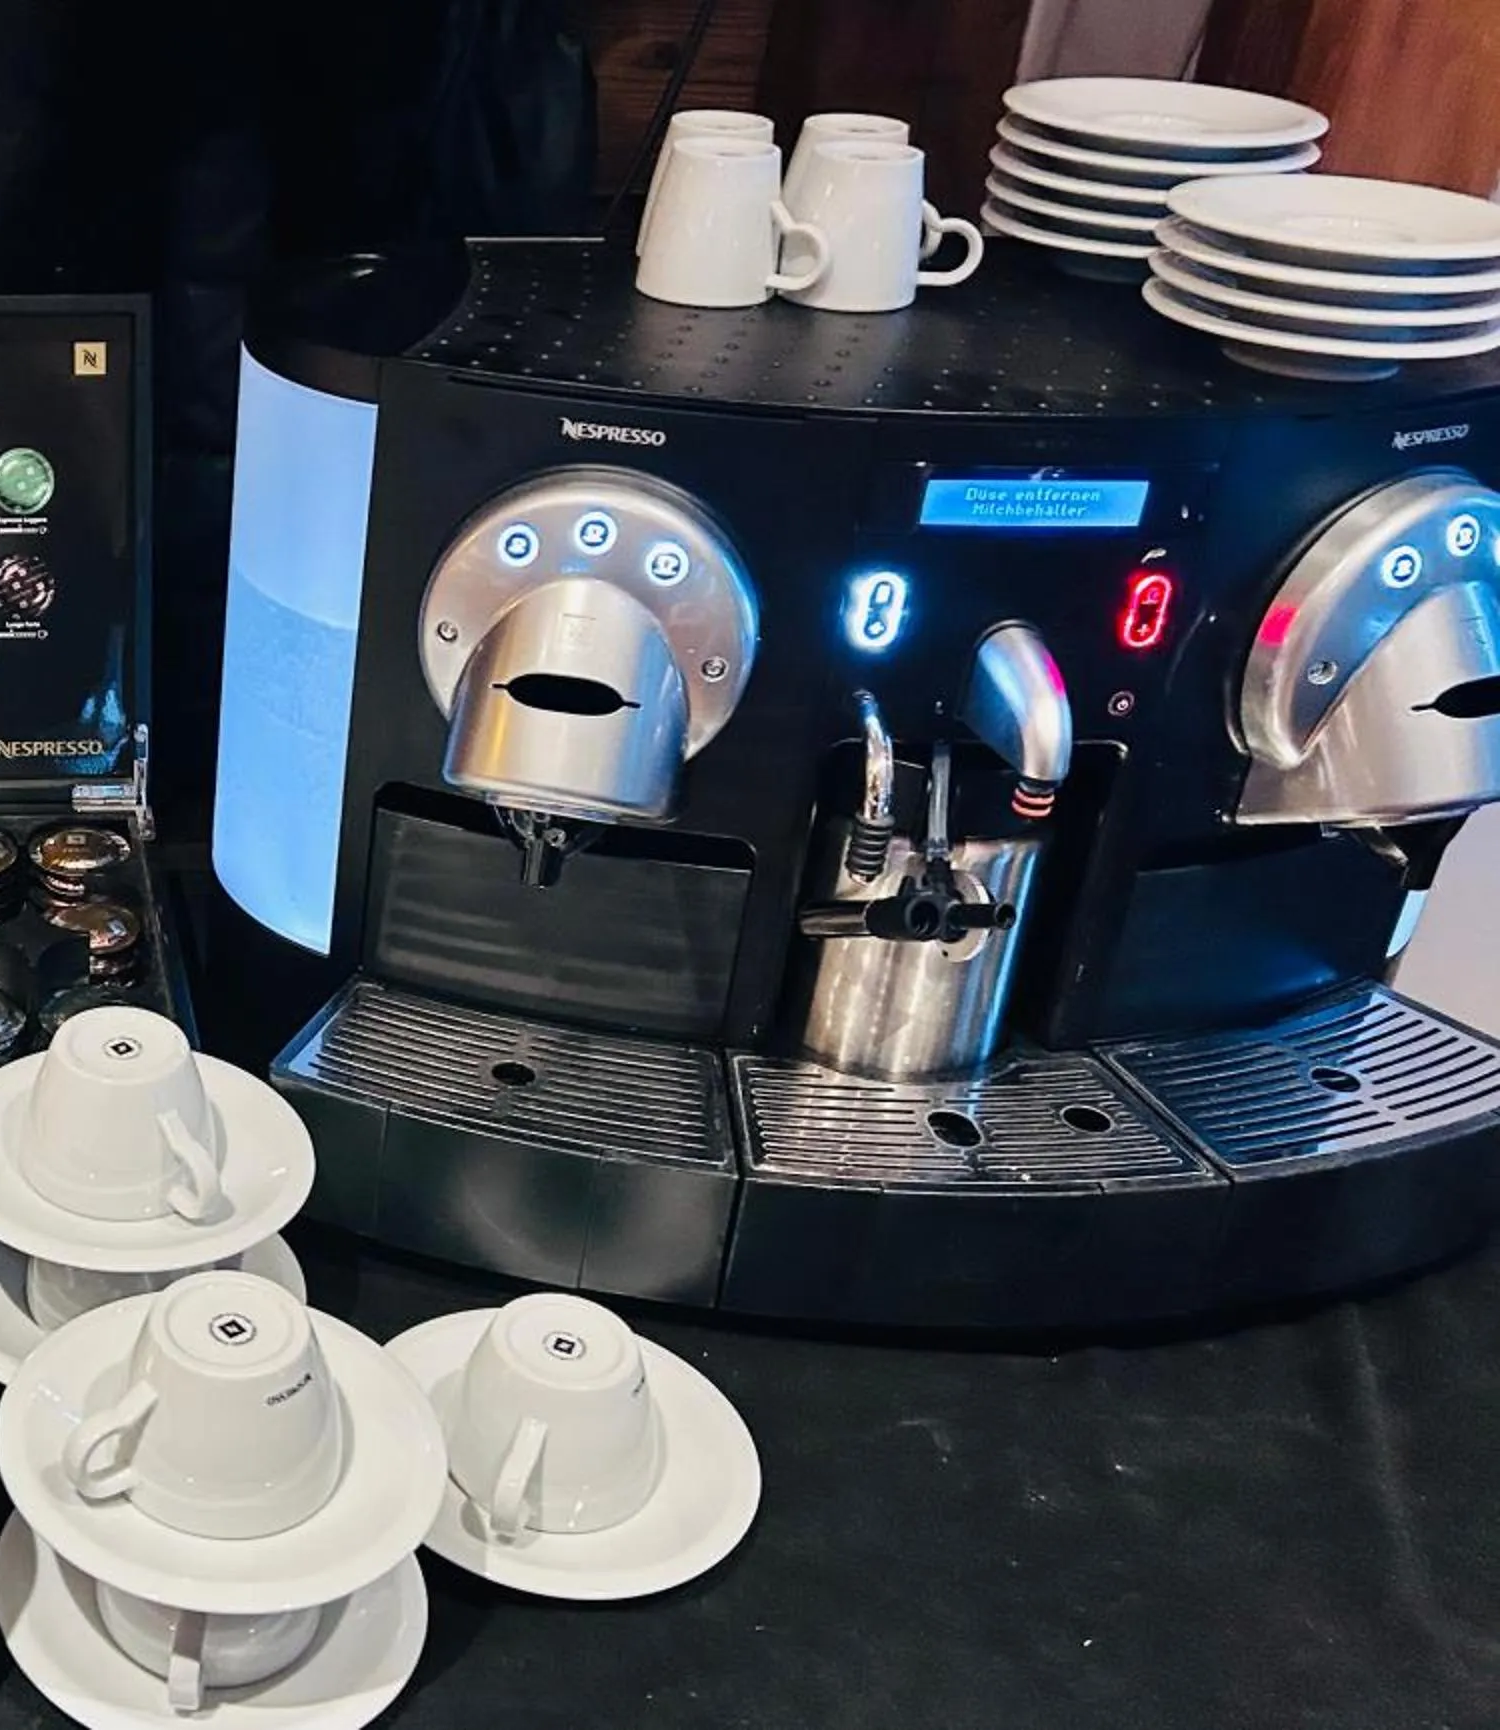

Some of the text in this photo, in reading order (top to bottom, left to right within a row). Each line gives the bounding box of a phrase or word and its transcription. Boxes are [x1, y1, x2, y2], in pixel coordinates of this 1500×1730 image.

[560, 417, 666, 446] NESPRESSO
[1392, 424, 1470, 450] NESPRESSO
[1015, 487, 1100, 502] entfernen
